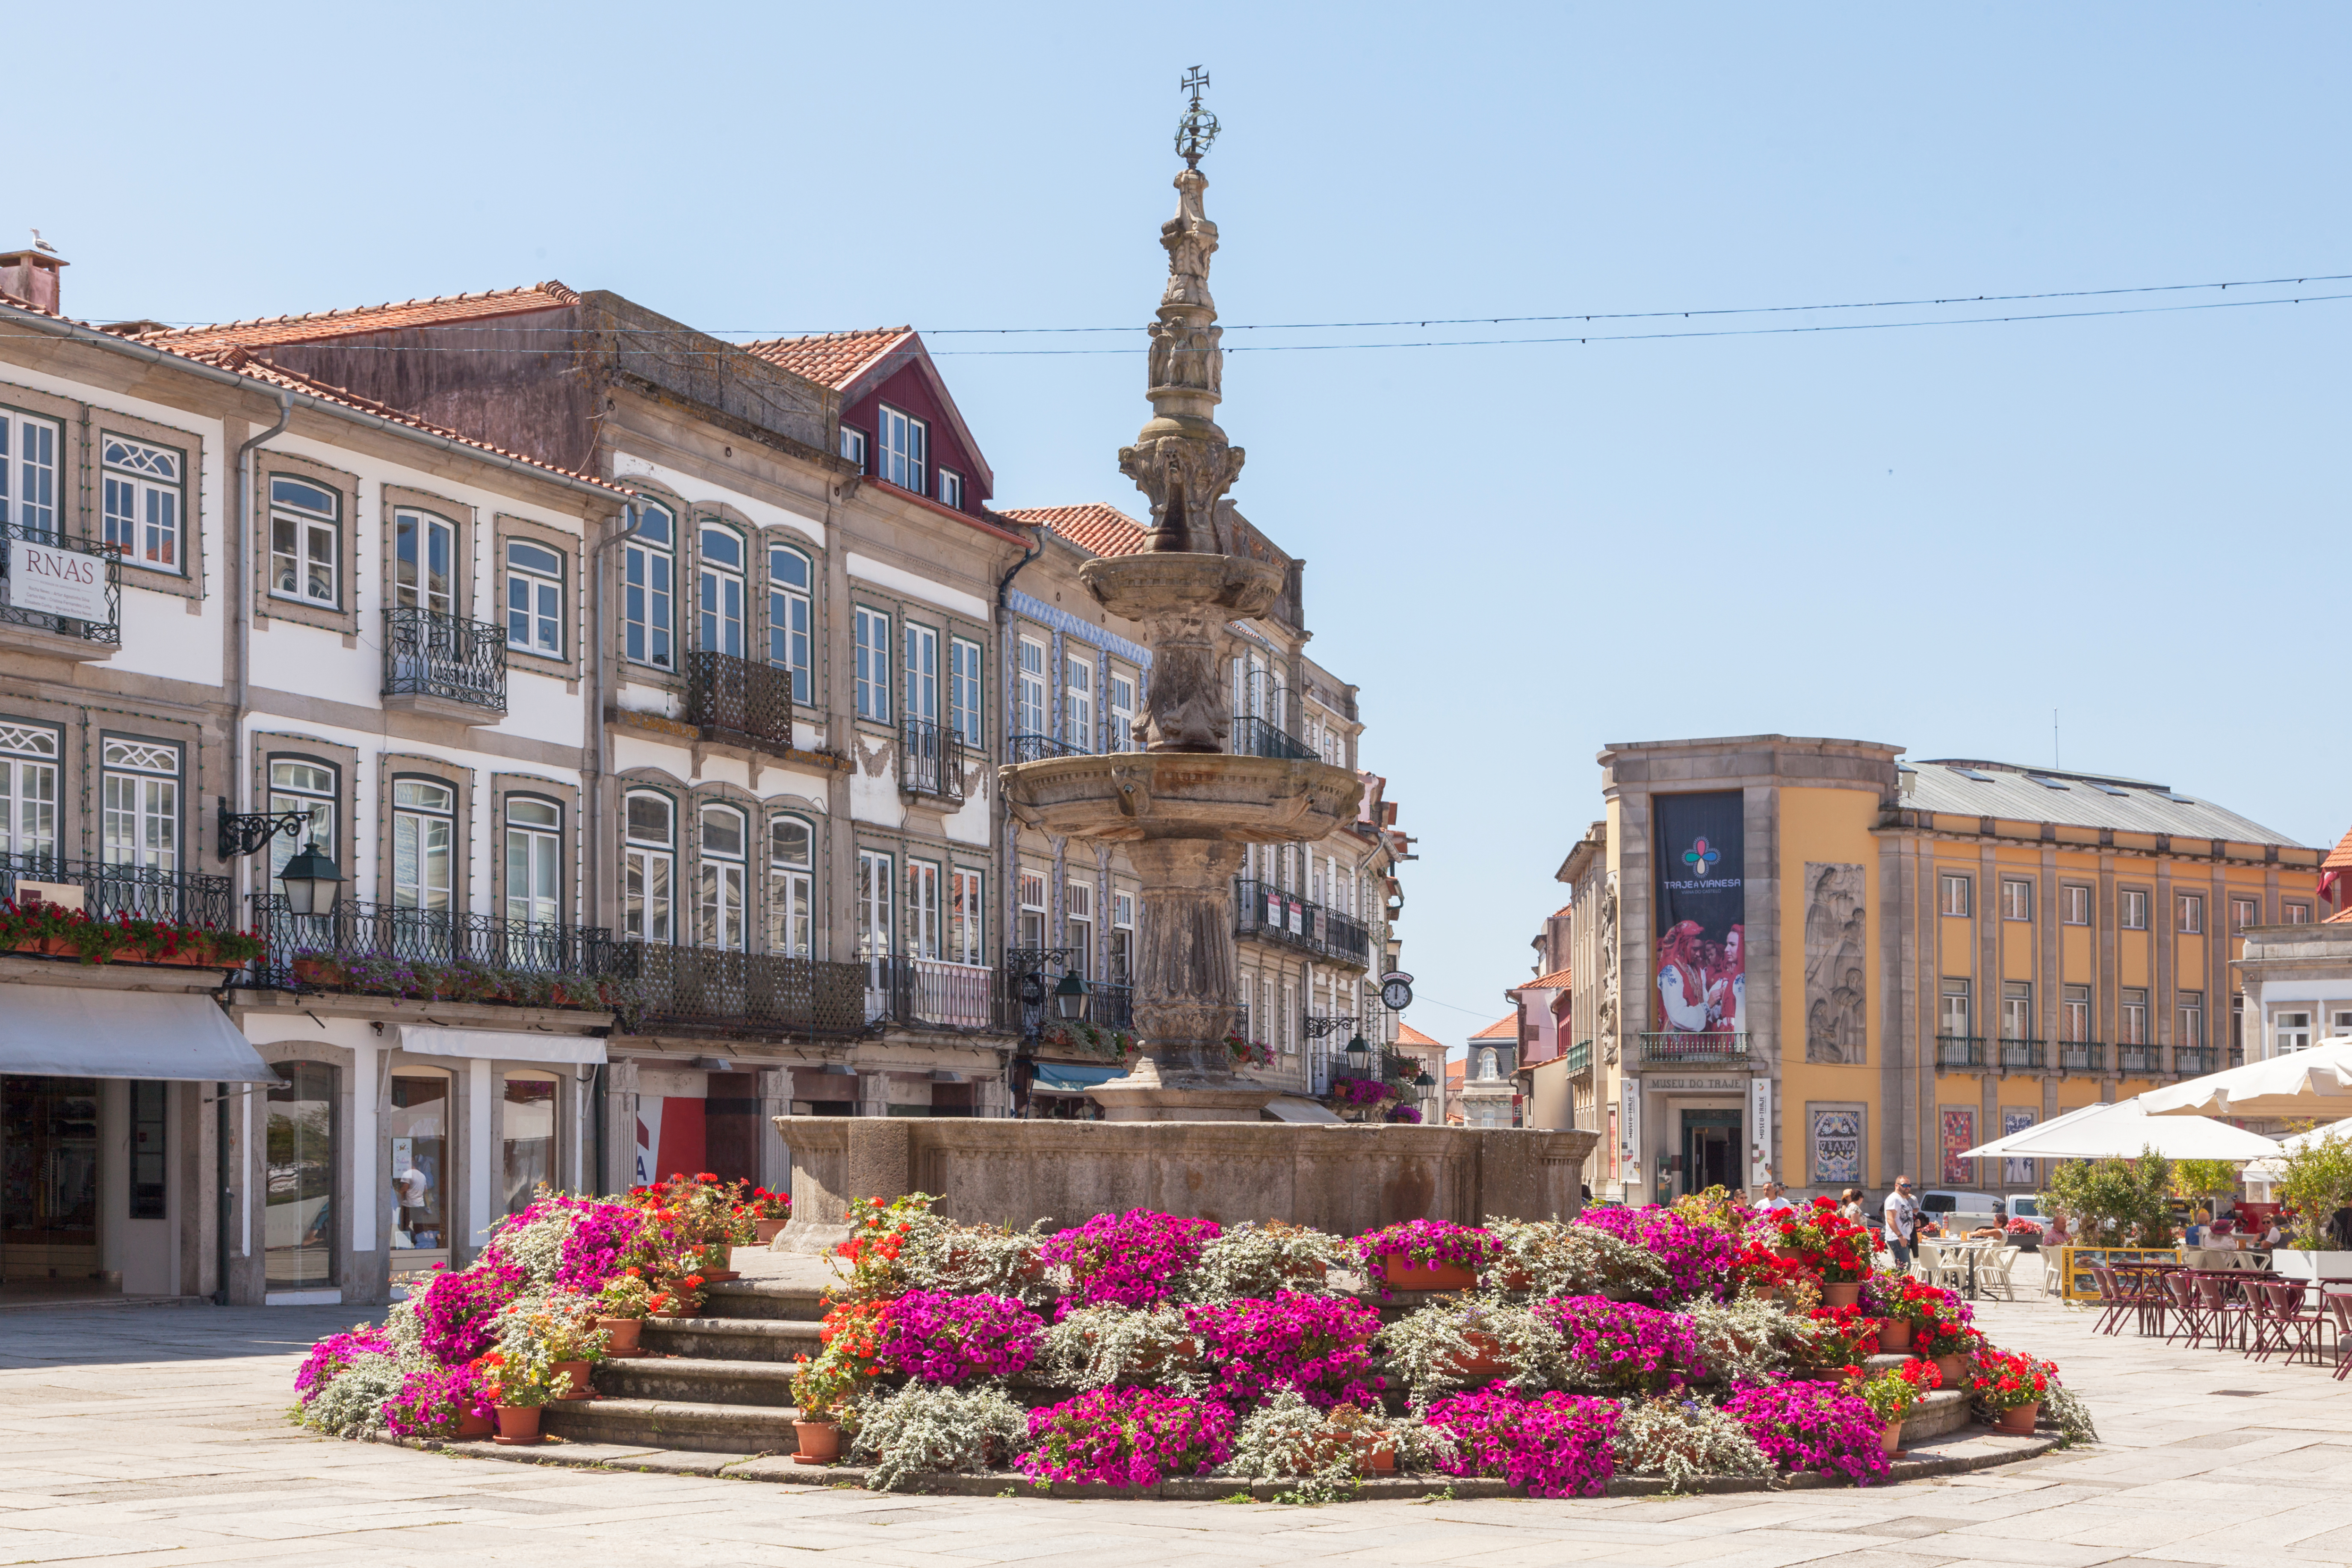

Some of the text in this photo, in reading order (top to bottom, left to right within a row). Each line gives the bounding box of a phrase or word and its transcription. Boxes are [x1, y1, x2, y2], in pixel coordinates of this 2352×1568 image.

[26, 549, 93, 585] RNAS
[1664, 881, 1693, 889] TRAJE
[1699, 879, 1741, 888] VIANESA
[1652, 1079, 1740, 1088] MUSEU DO TRAJE
[1819, 1141, 1855, 1151] VIANA
